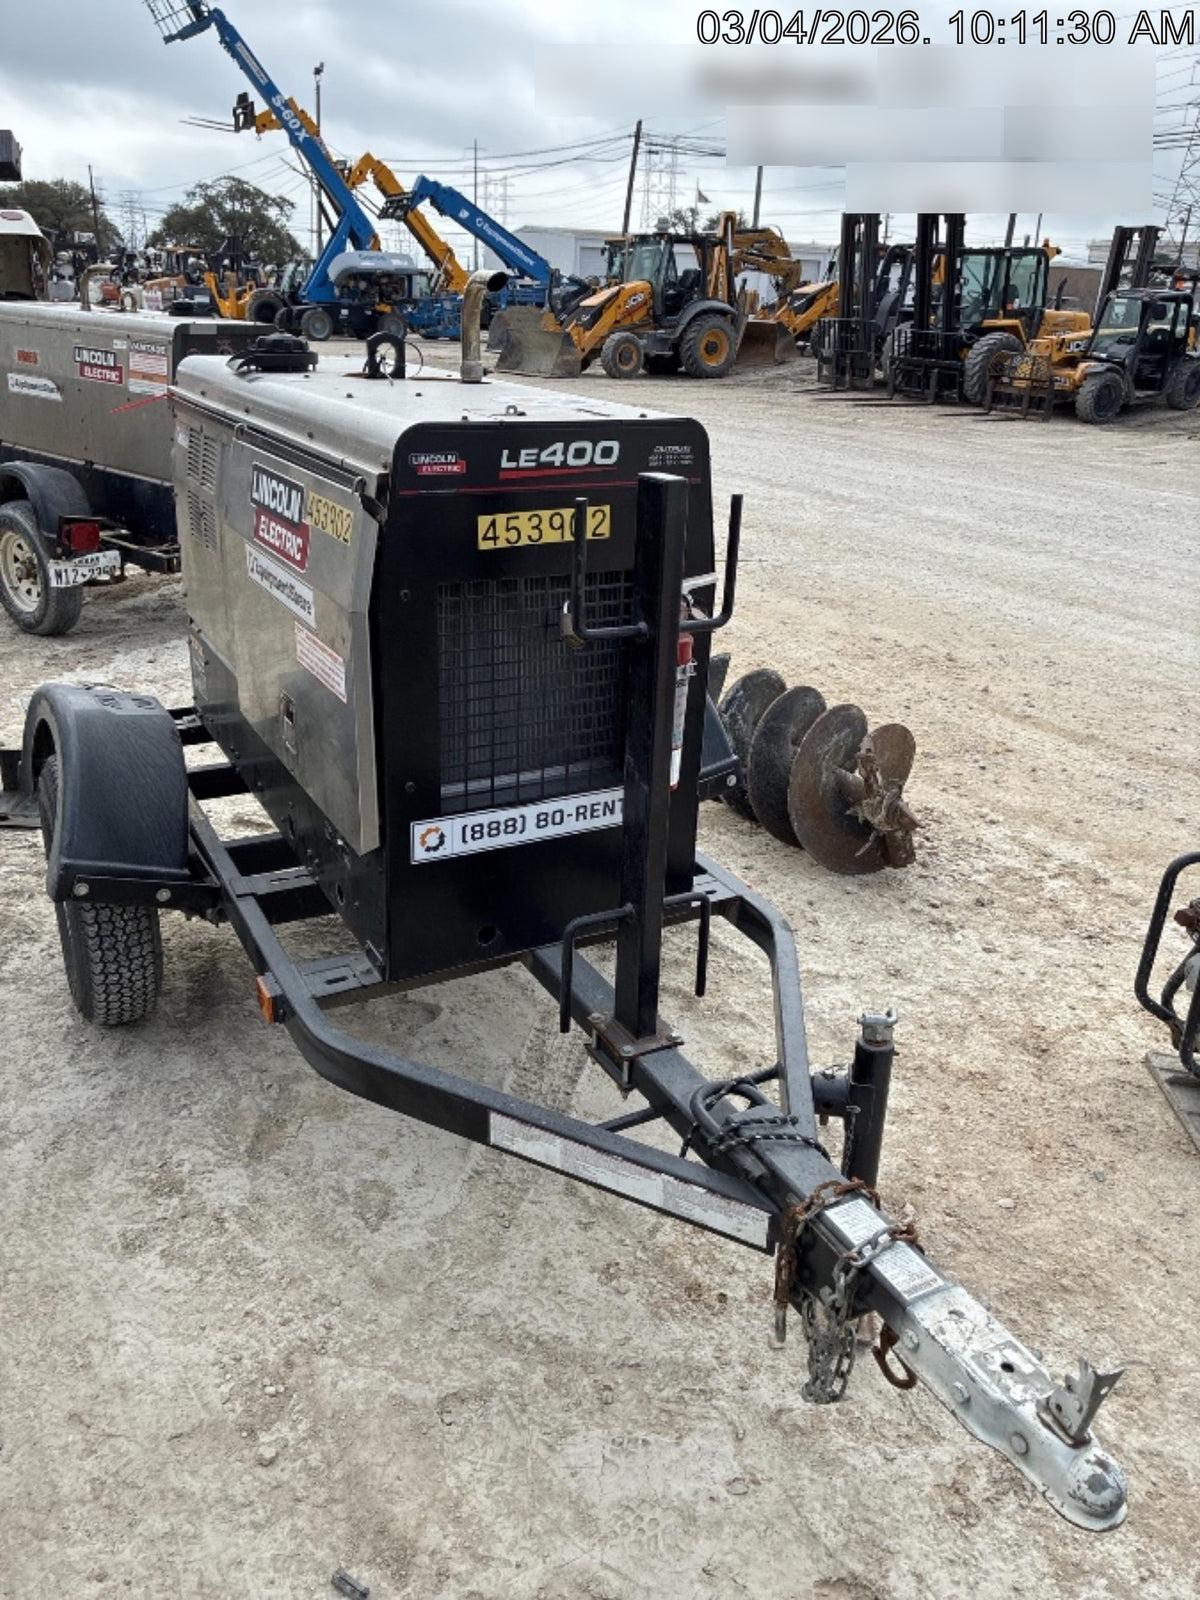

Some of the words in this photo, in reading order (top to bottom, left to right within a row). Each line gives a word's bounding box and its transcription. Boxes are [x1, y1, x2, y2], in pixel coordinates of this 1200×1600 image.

[75, 349, 115, 366] LINCOLN
[83, 366, 120, 382] ELECTRIC
[408, 454, 457, 465] LINCOLN
[500, 440, 620, 469] LE400
[252, 471, 302, 523] LINCOLN
[307, 495, 352, 543] 453902
[259, 515, 303, 561] ELECTRIC
[461, 814, 526, 844] (888)
